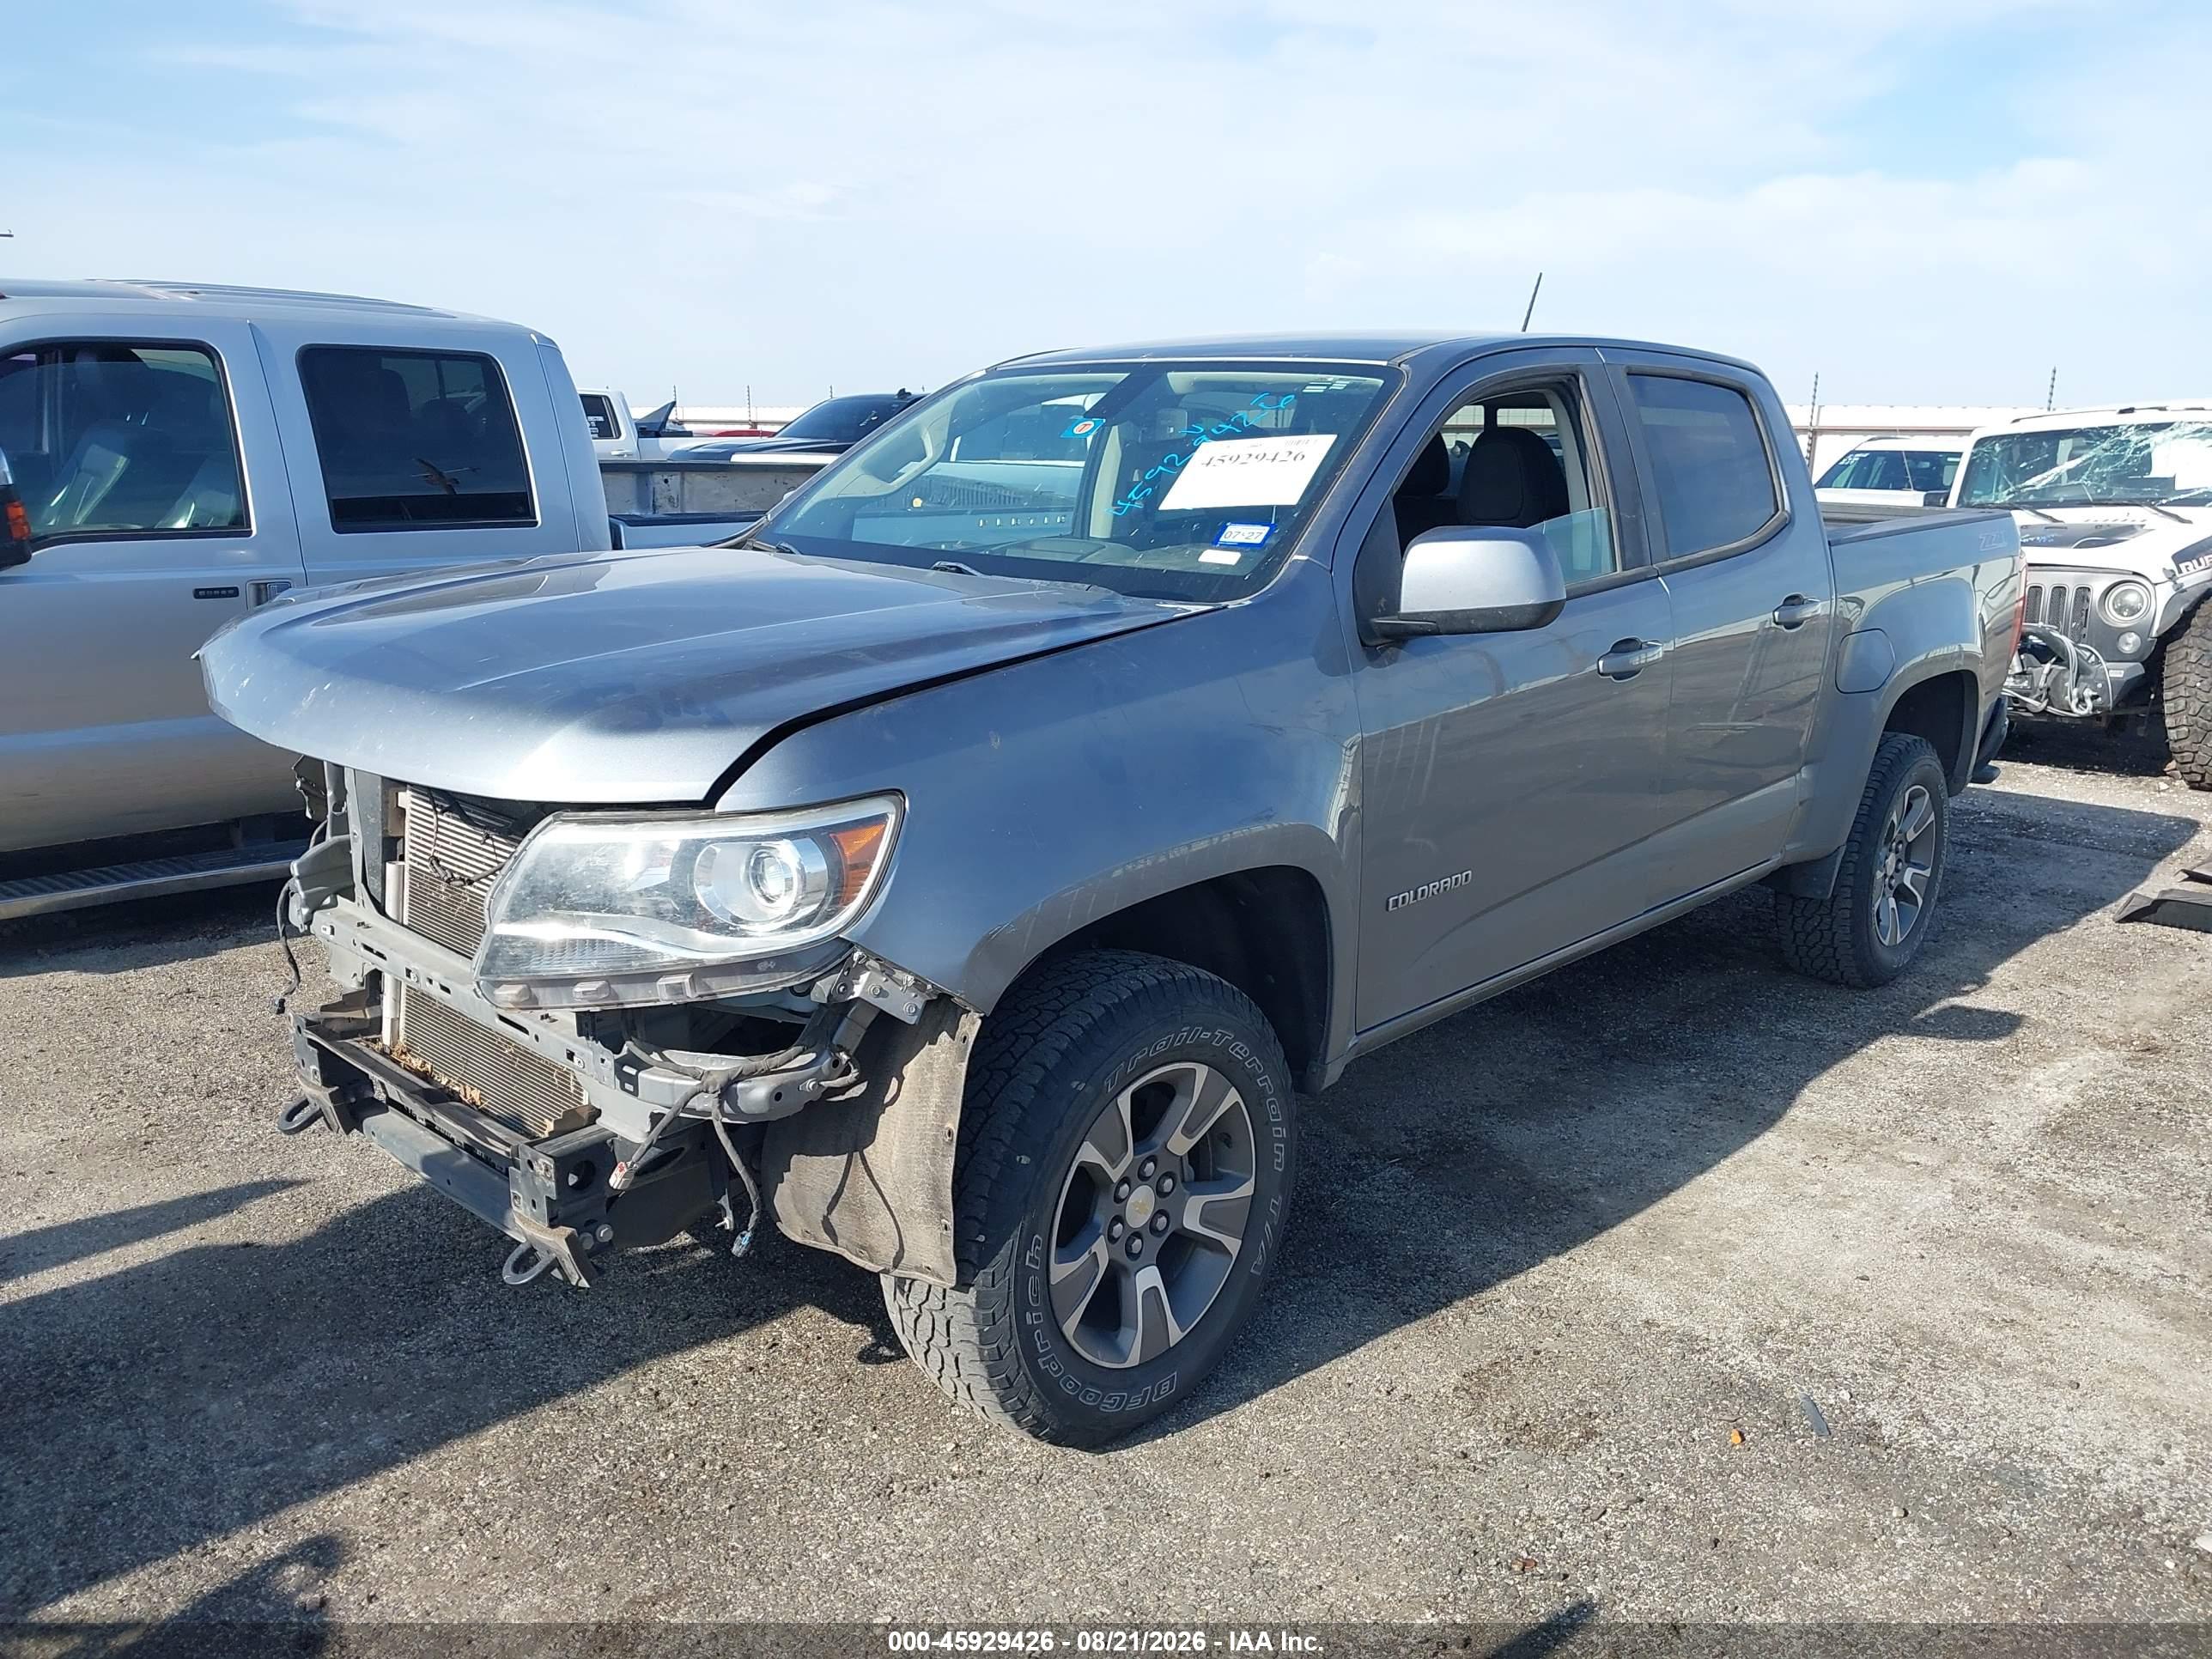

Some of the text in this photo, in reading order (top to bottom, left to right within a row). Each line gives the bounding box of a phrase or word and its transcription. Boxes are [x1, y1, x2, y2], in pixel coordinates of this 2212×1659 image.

[1201, 450, 1306, 468] 45929426
[1387, 870, 1473, 912] COLORADO
[1103, 1025, 1285, 1170] Trail-Terrain
[1024, 1233, 1179, 1413] BFGoodrich
